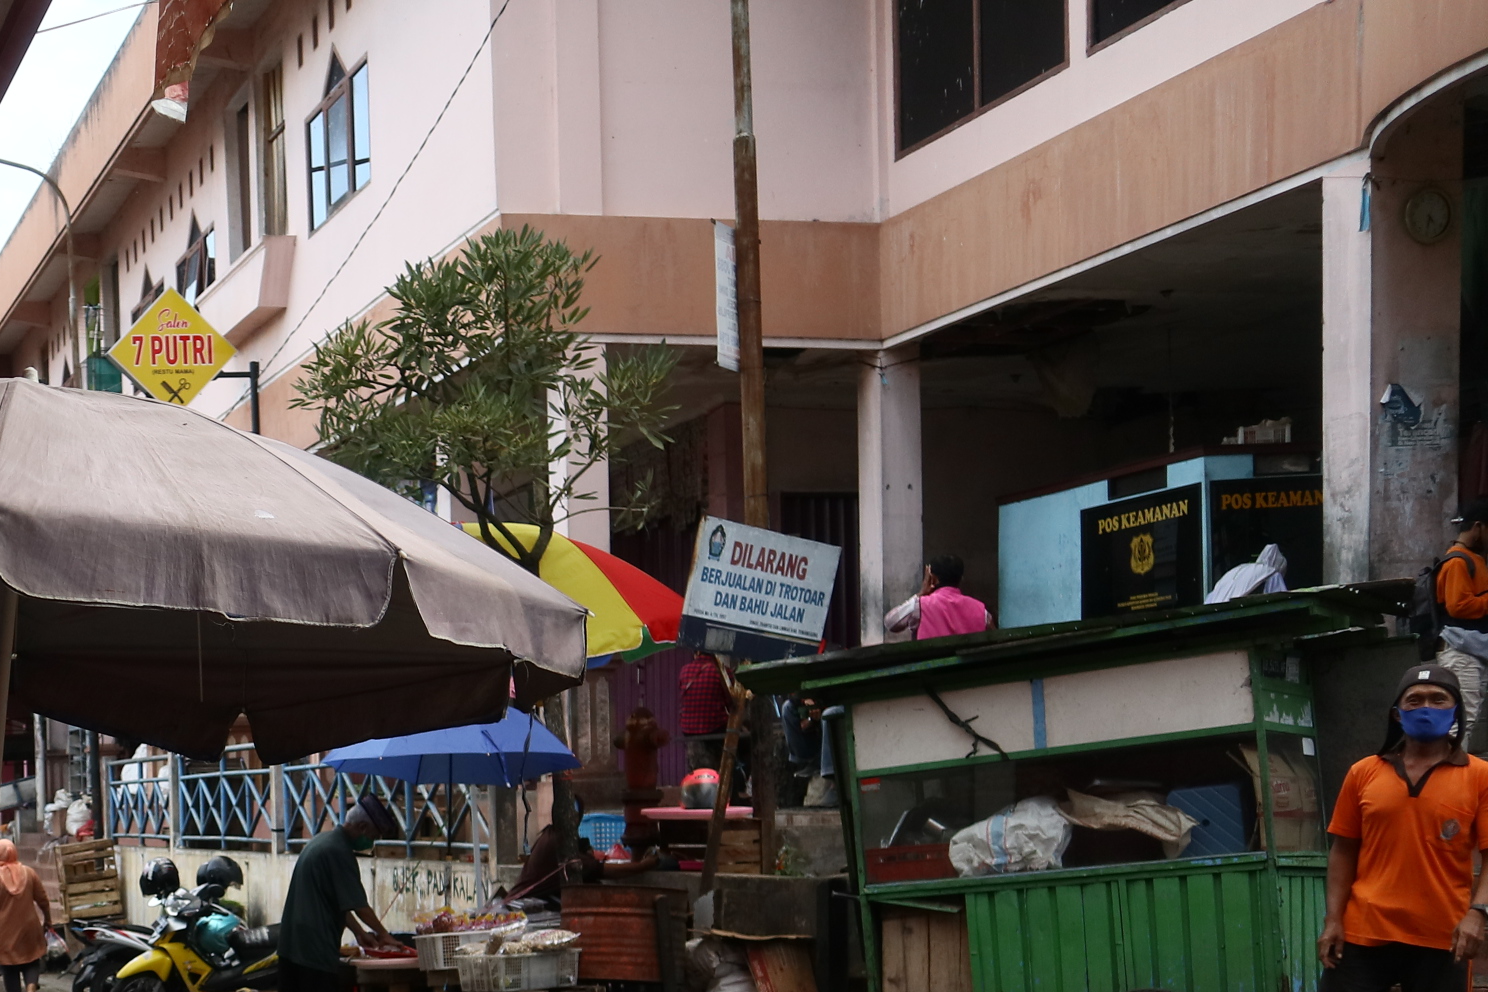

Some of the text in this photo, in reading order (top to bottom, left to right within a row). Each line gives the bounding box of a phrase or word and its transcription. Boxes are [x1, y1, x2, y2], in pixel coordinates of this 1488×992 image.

[131, 335, 214, 366] 7 PUTRI
[1097, 499, 1189, 535] POS KEAMANAN
[1220, 492, 1252, 511] POS
[730, 541, 809, 581] DILARANG
[700, 566, 826, 607] BERJUALAN DI TROTOAR
[713, 591, 738, 610] DAN
[739, 596, 770, 616] BAHU
[770, 603, 806, 623] JALAN
